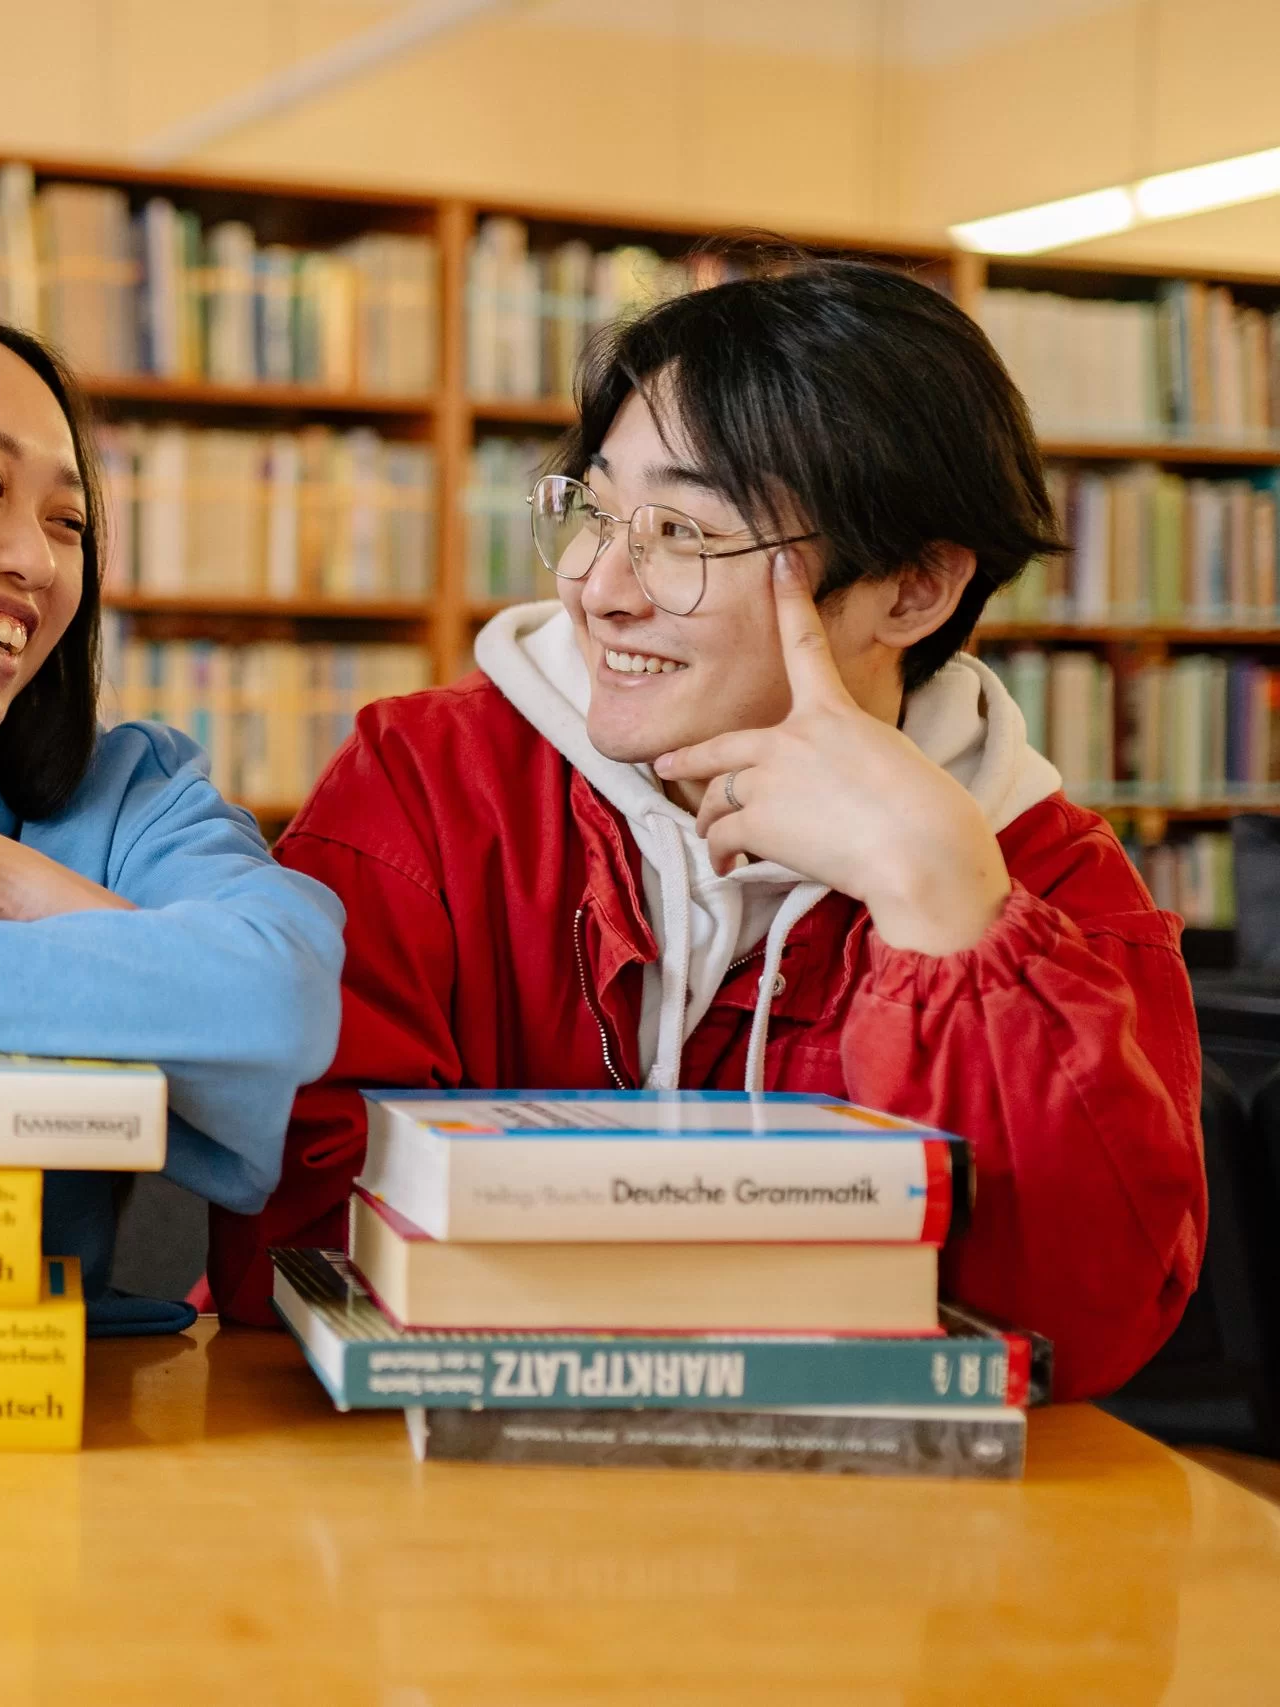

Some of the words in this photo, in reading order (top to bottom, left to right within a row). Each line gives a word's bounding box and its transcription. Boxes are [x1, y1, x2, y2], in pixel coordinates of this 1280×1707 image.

[611, 1176, 726, 1205] Deutsche
[734, 1176, 879, 1206] Grammatik
[491, 1351, 746, 1398] MARKTPLATZ
